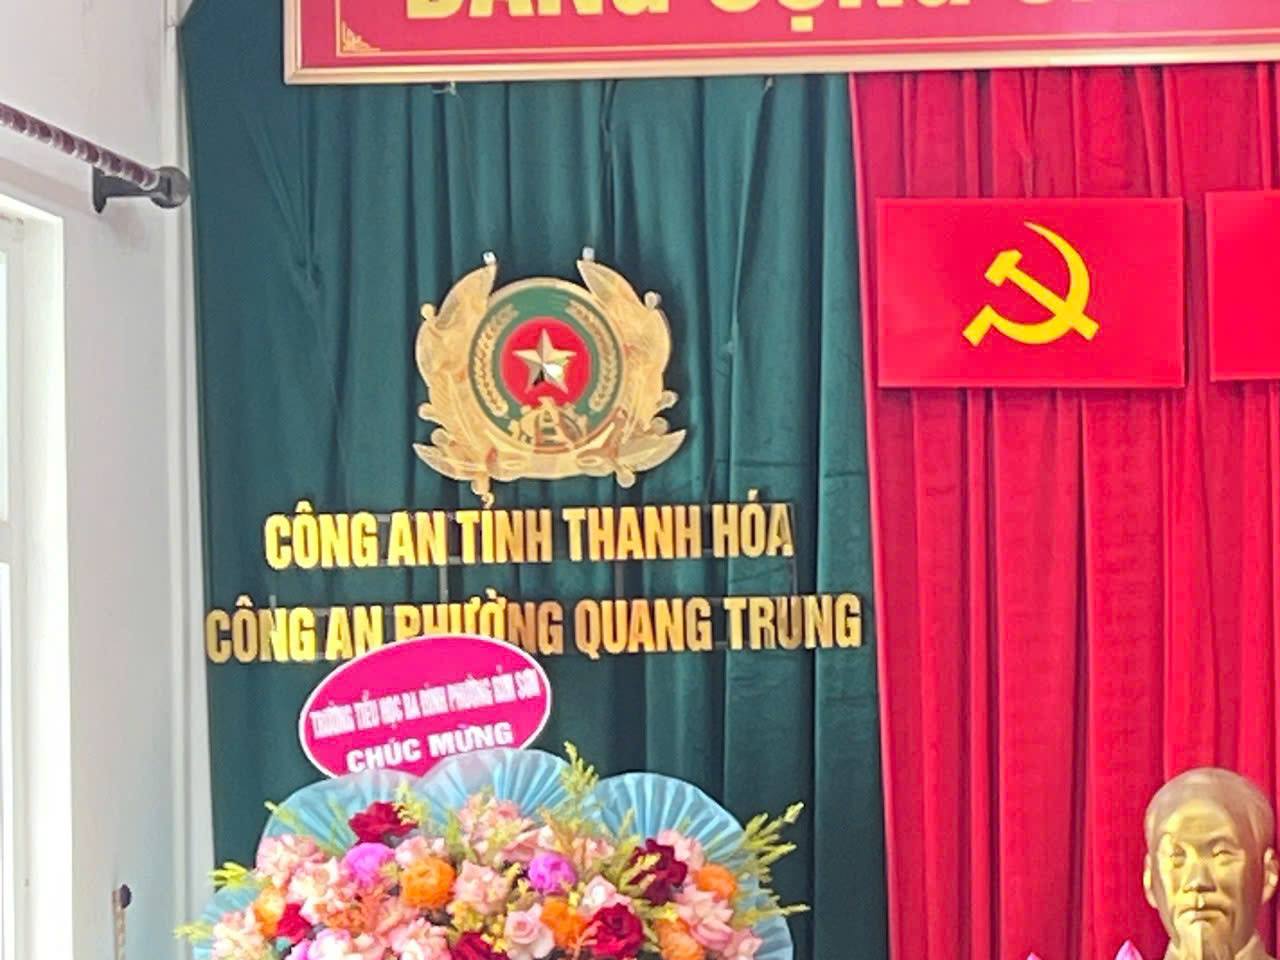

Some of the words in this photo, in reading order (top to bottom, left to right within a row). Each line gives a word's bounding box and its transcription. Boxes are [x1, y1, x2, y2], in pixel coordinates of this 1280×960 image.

[264, 501, 378, 570] CÔNG
[387, 510, 448, 566] AN
[455, 494, 553, 564] TỈNH
[561, 504, 701, 561] THANH
[711, 490, 793, 558] HÓA
[204, 594, 316, 663] CÔNG
[325, 604, 383, 660] AN
[574, 597, 712, 660] QUANG
[724, 594, 862, 651] TRUNG
[346, 737, 422, 773] CHÚC
[428, 721, 514, 757] MỪNG
